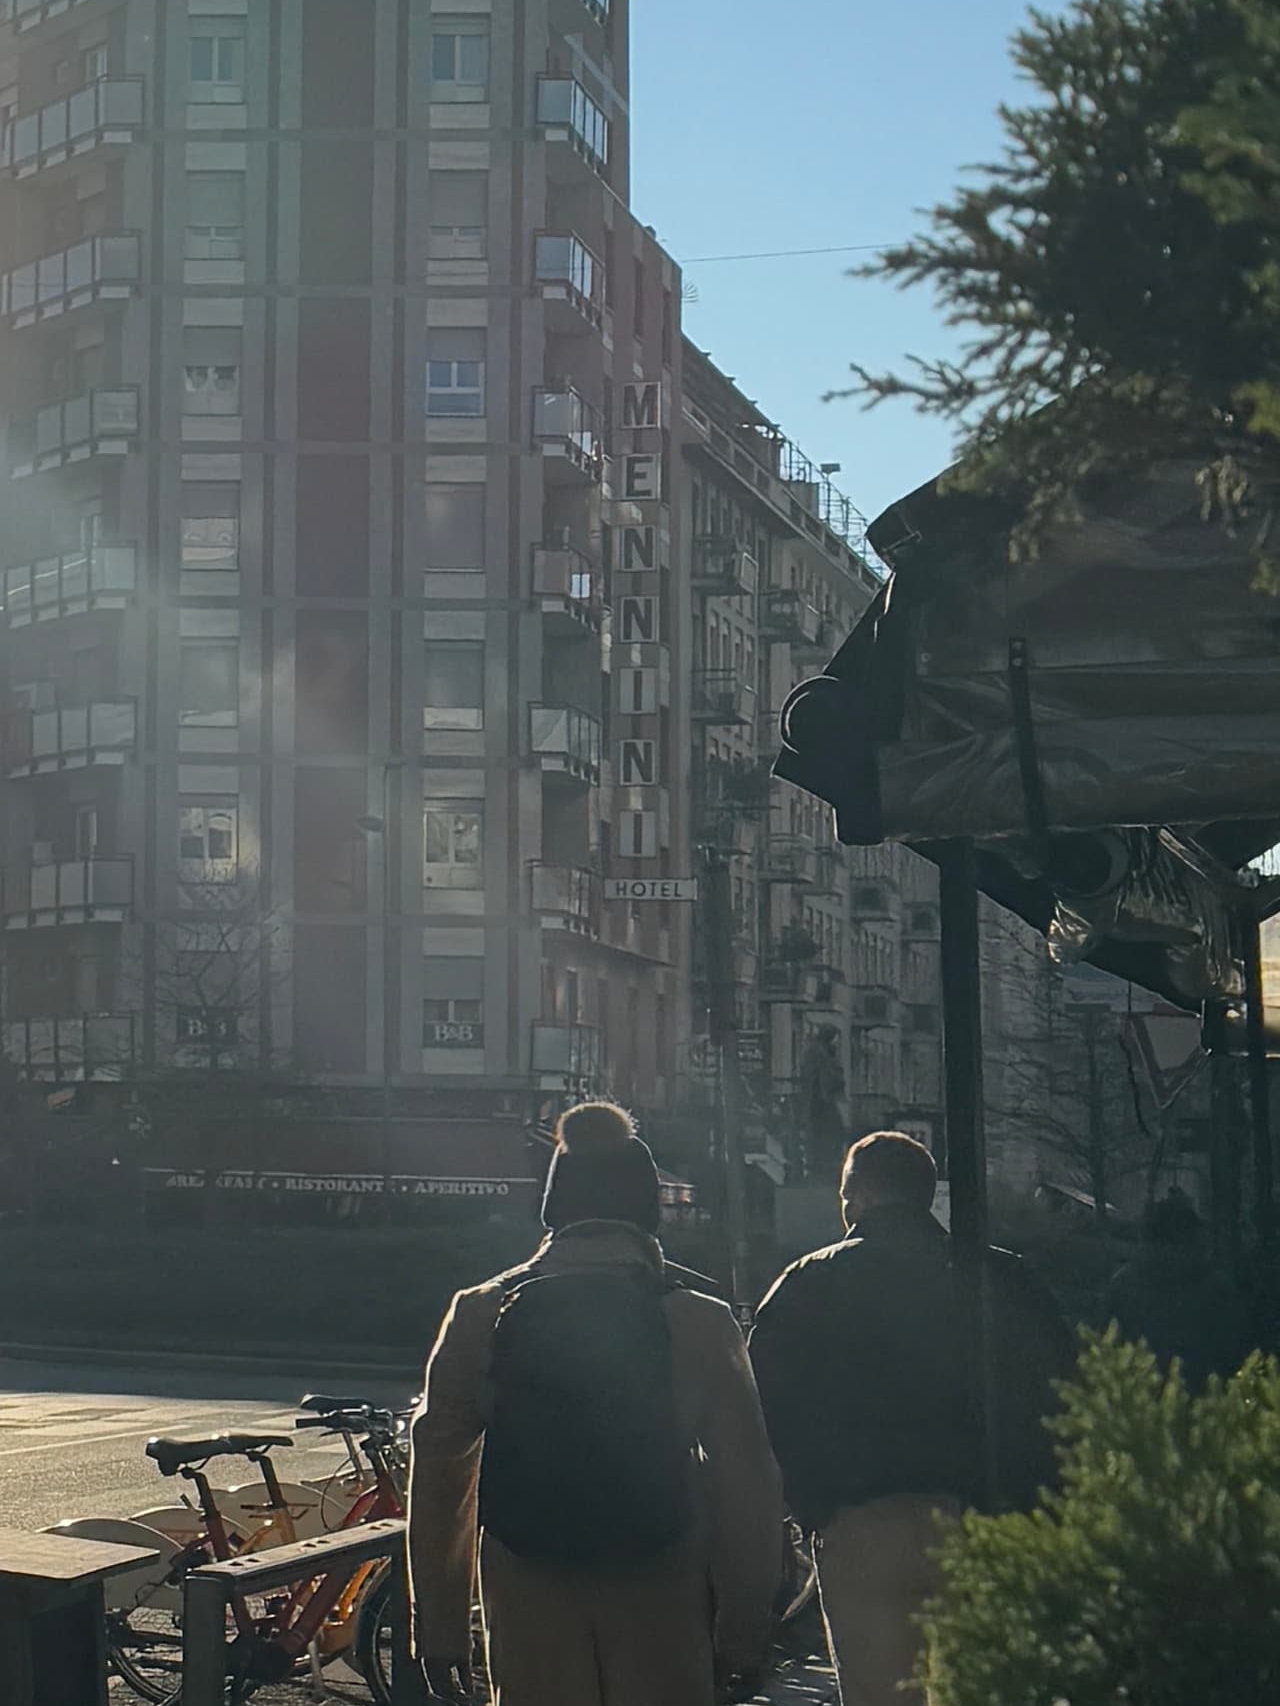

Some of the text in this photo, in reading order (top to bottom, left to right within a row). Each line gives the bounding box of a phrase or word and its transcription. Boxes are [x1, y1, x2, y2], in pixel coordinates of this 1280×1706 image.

[622, 383, 659, 855] MENNINI
[616, 881, 682, 898] HOTEL
[434, 1023, 474, 1041] B&B
[285, 1177, 397, 1192] RISTORANT
[415, 1181, 510, 1195] APERITIVO
